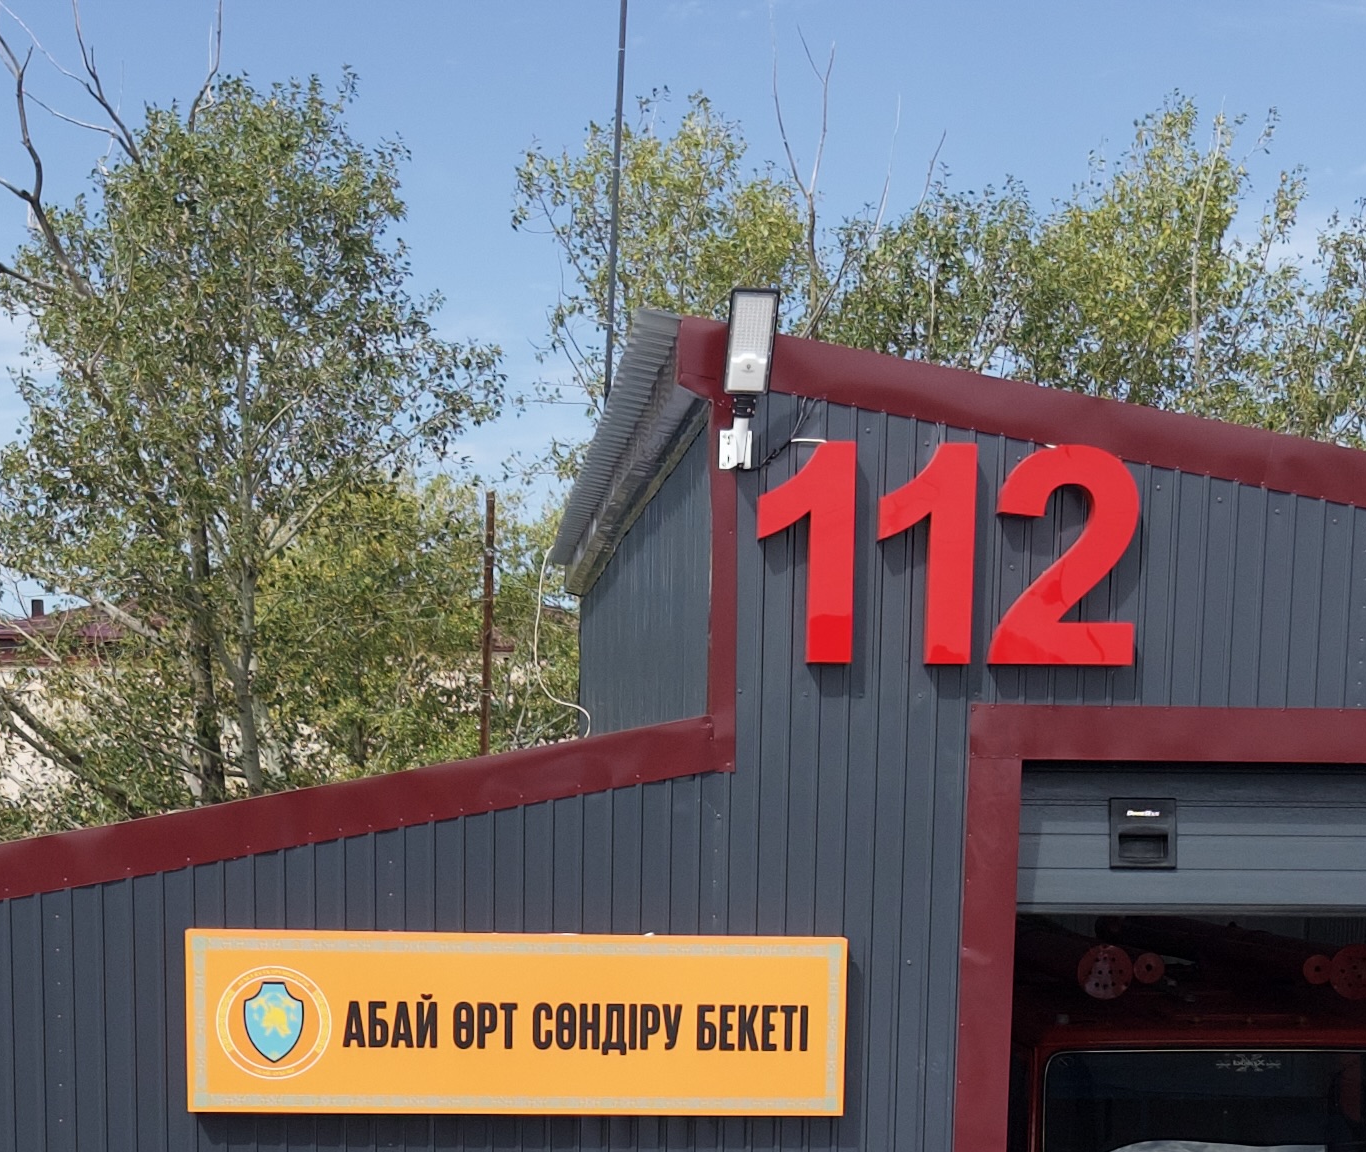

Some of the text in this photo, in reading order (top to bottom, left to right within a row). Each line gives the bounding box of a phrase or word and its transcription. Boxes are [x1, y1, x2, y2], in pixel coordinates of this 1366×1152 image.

[756, 441, 1141, 667] 112
[342, 993, 437, 1048] АБАЙ
[453, 1001, 518, 1050] ӨРТ
[532, 1002, 683, 1055] СӨНДІРУ
[696, 1004, 809, 1052] БЕКЕТІ
